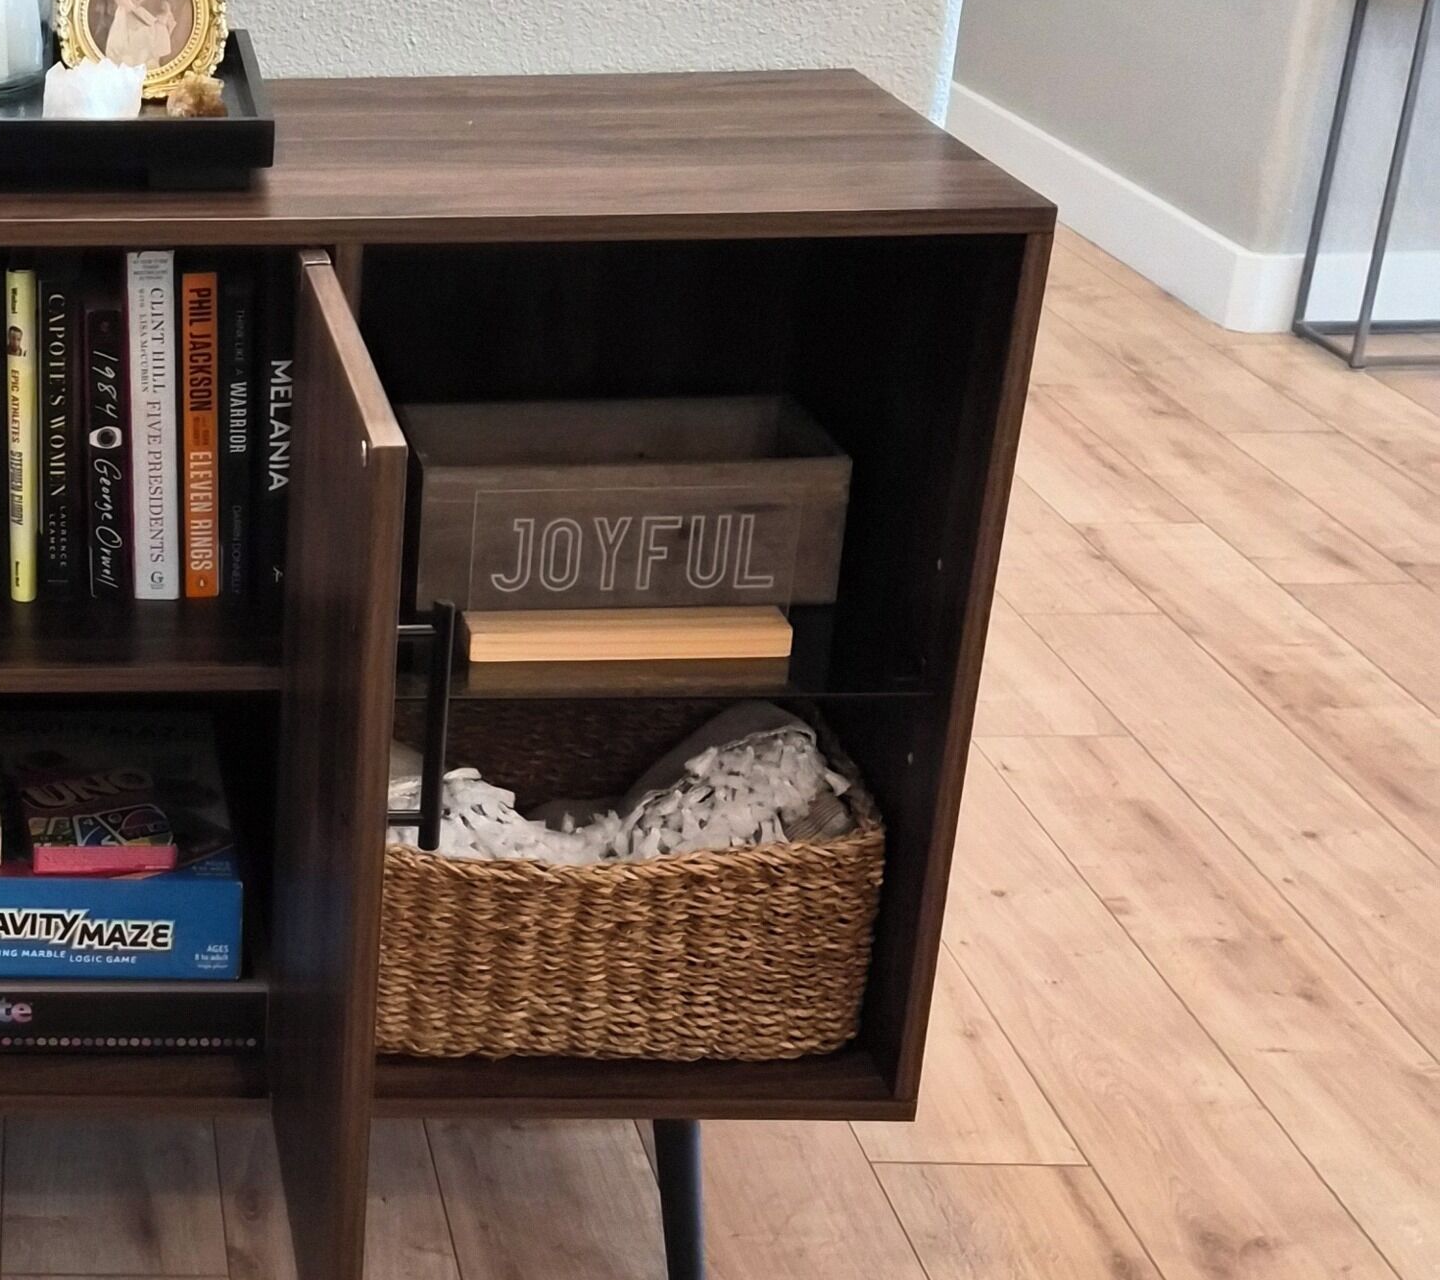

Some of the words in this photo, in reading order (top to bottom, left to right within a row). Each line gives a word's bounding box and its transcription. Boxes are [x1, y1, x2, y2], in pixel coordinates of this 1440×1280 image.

[140, 314, 148, 337] LISA
[150, 288, 165, 344] CLINT
[189, 288, 212, 326] PHIL
[235, 309, 244, 338] THINK
[47, 293, 67, 406] CAPOTE'S
[152, 351, 166, 393] HILL
[189, 332, 212, 410] JACKSON
[234, 342, 244, 361] LIKE
[11, 369, 20, 392] EPIC
[92, 350, 119, 418] 1984
[11, 395, 20, 443] ATHLETES
[146, 401, 162, 444] FIVE
[229, 382, 247, 453] WARRIOR
[268, 360, 293, 491] MELANIA
[49, 415, 66, 496] WOMEN
[190, 451, 212, 512] ELEVEN
[94, 458, 122, 521] George
[148, 450, 164, 563] PRESIDENTS
[59, 506, 67, 568] LAURENCE
[97, 526, 122, 588] Orwell
[190, 519, 212, 570] RINGS
[490, 514, 775, 593] JOYFUL
[21, 767, 154, 809] UNO
[22, 950, 65, 959] MARBLE
[70, 955, 102, 964] LOGIC
[106, 956, 137, 964] GAME
[78, 920, 172, 947] MAZE
[207, 945, 229, 953] AGES
